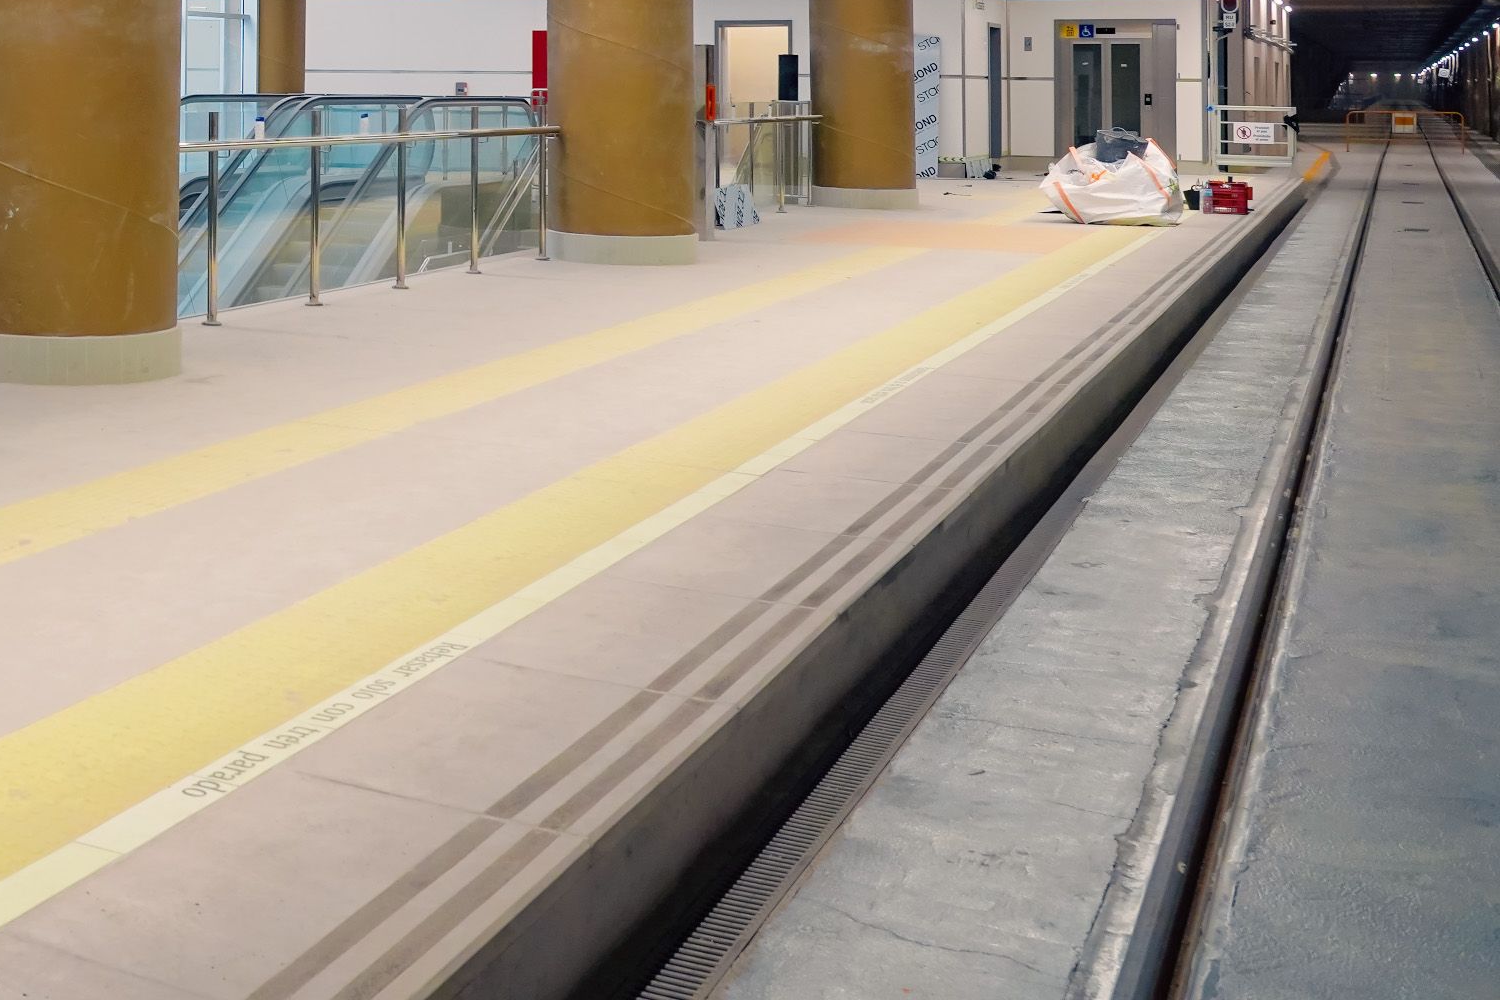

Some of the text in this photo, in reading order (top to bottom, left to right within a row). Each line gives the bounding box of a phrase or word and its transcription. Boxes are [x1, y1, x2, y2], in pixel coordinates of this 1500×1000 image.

[914, 114, 937, 131] OND
[181, 642, 468, 797] Rebasar solo con tren parado
